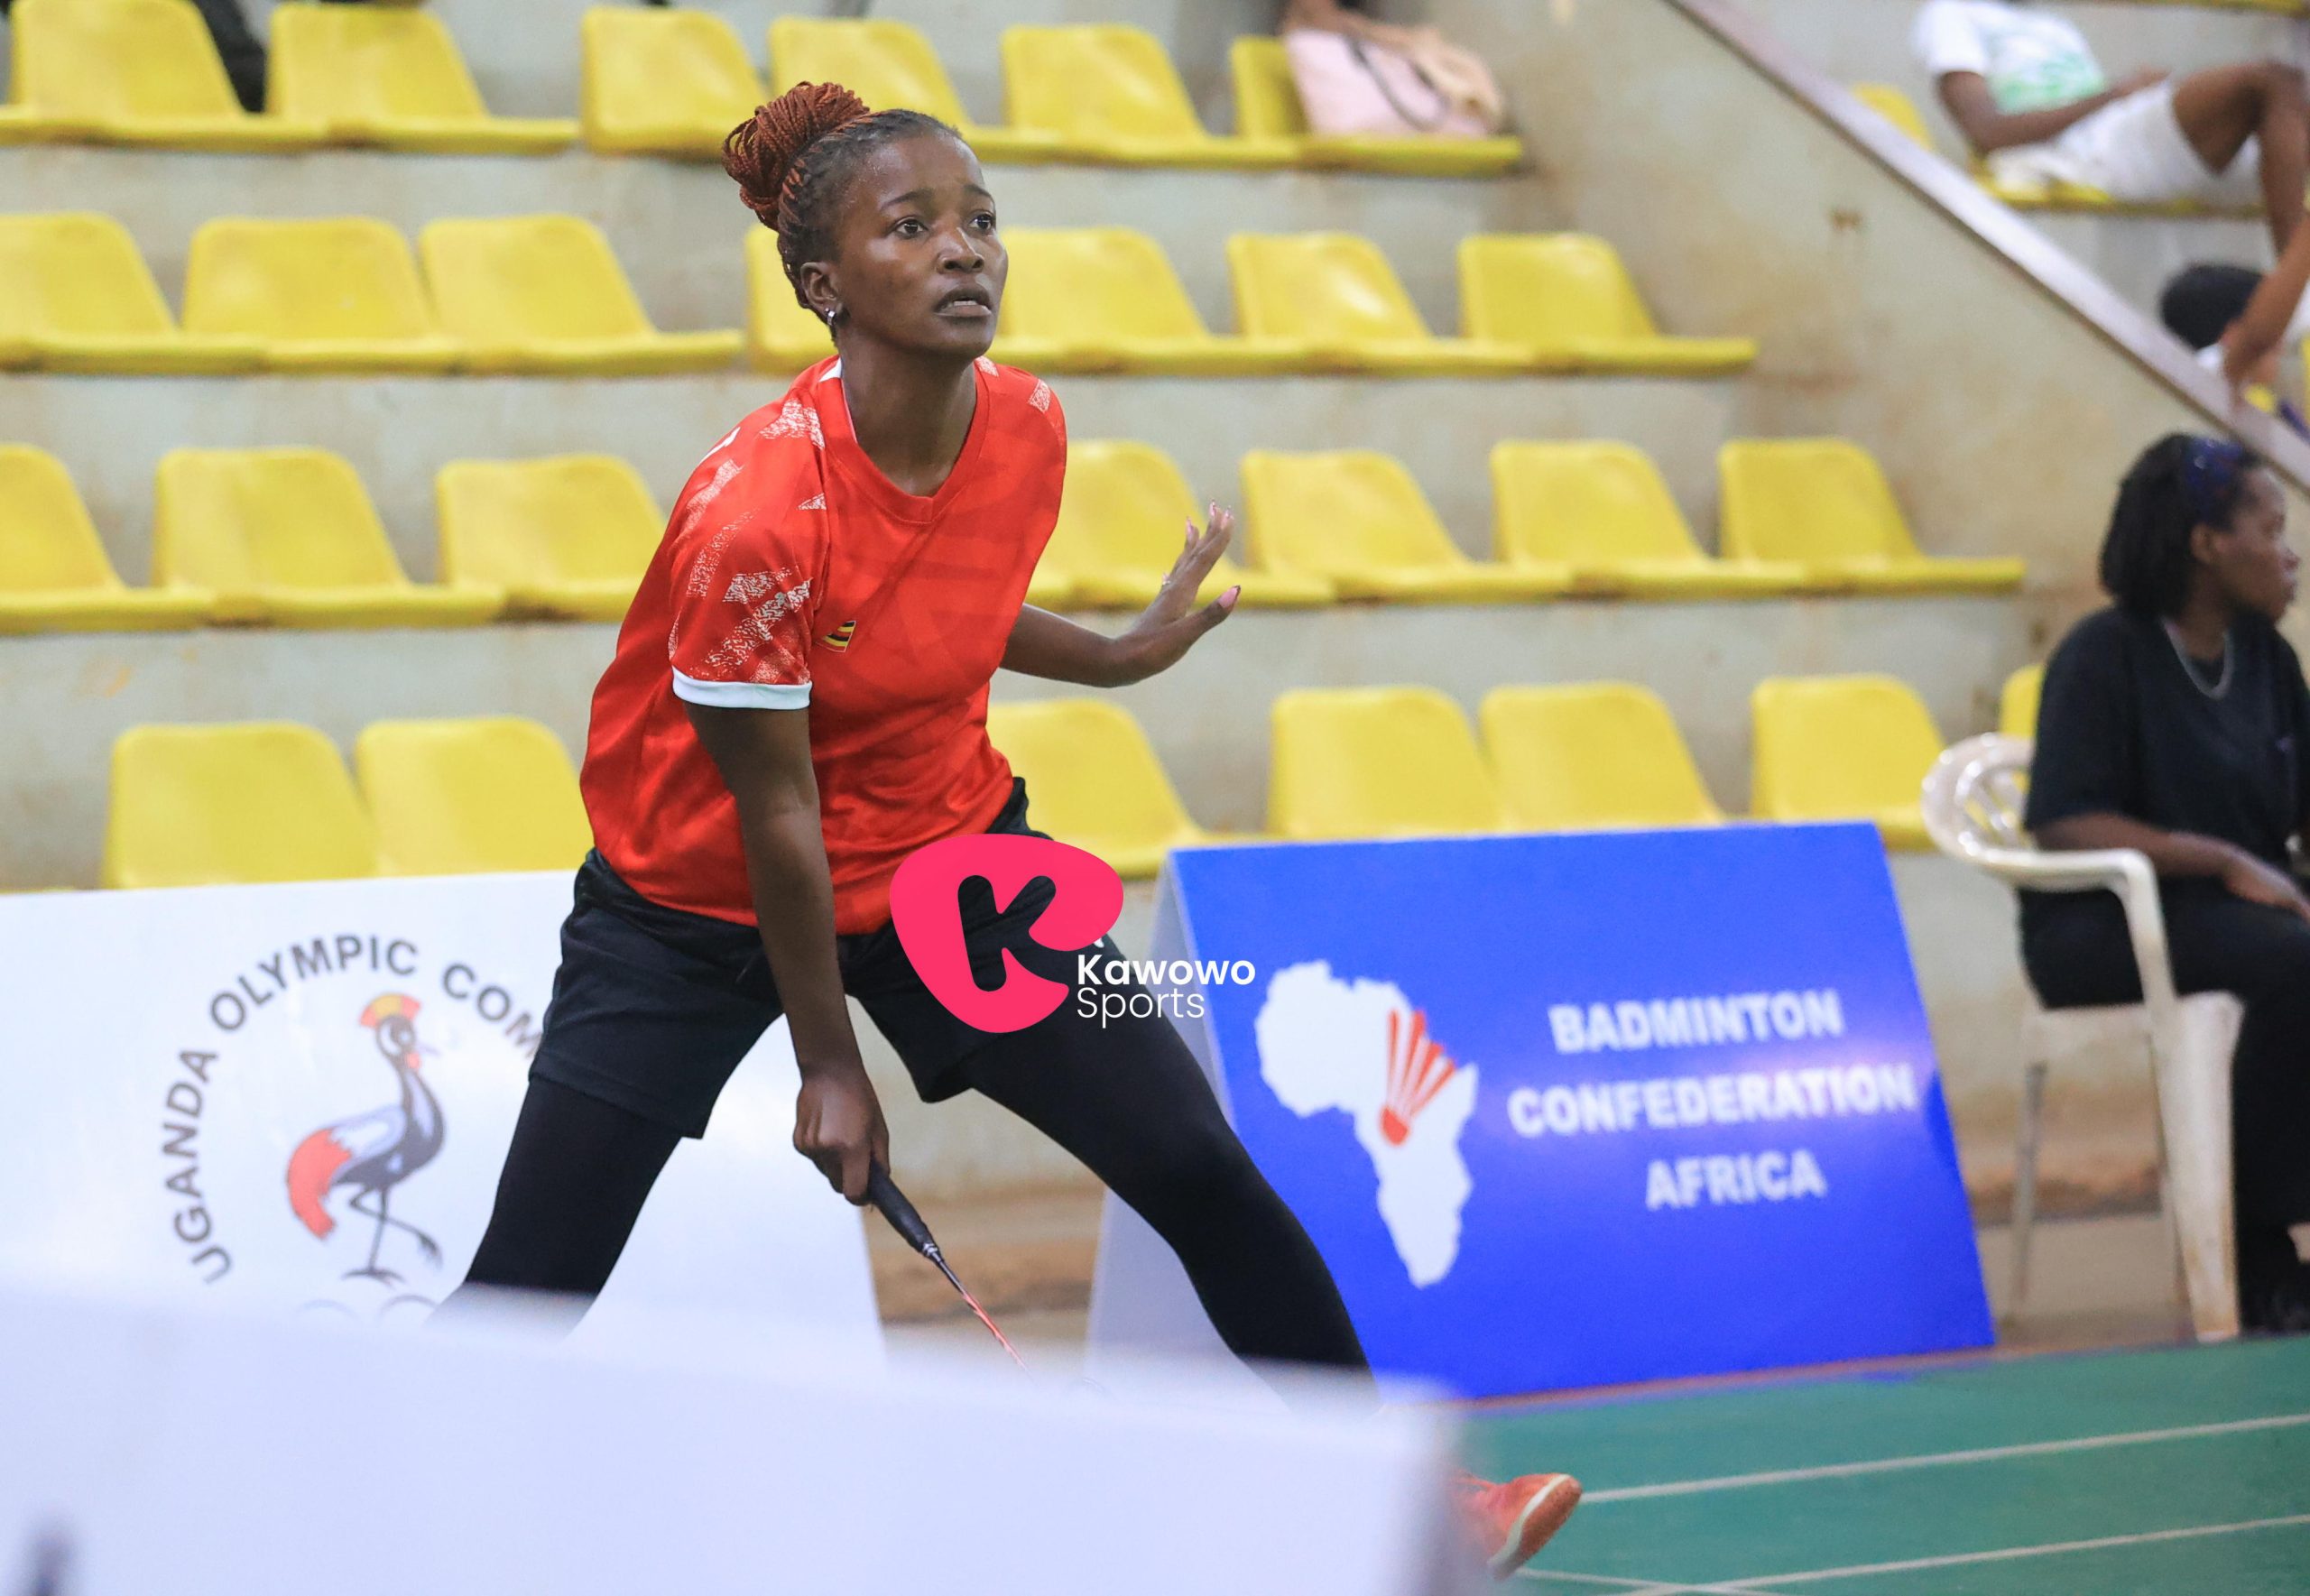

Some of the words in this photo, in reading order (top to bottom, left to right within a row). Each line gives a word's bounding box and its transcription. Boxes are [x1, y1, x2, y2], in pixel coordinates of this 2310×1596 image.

[1548, 989, 1843, 1054] BADMINTON
[162, 1049, 232, 1284] UGANDA
[209, 933, 419, 1031] OLYMPIC
[1508, 1063, 1917, 1138] CONFEDERATION
[1646, 1149, 1827, 1211] AFRICA
